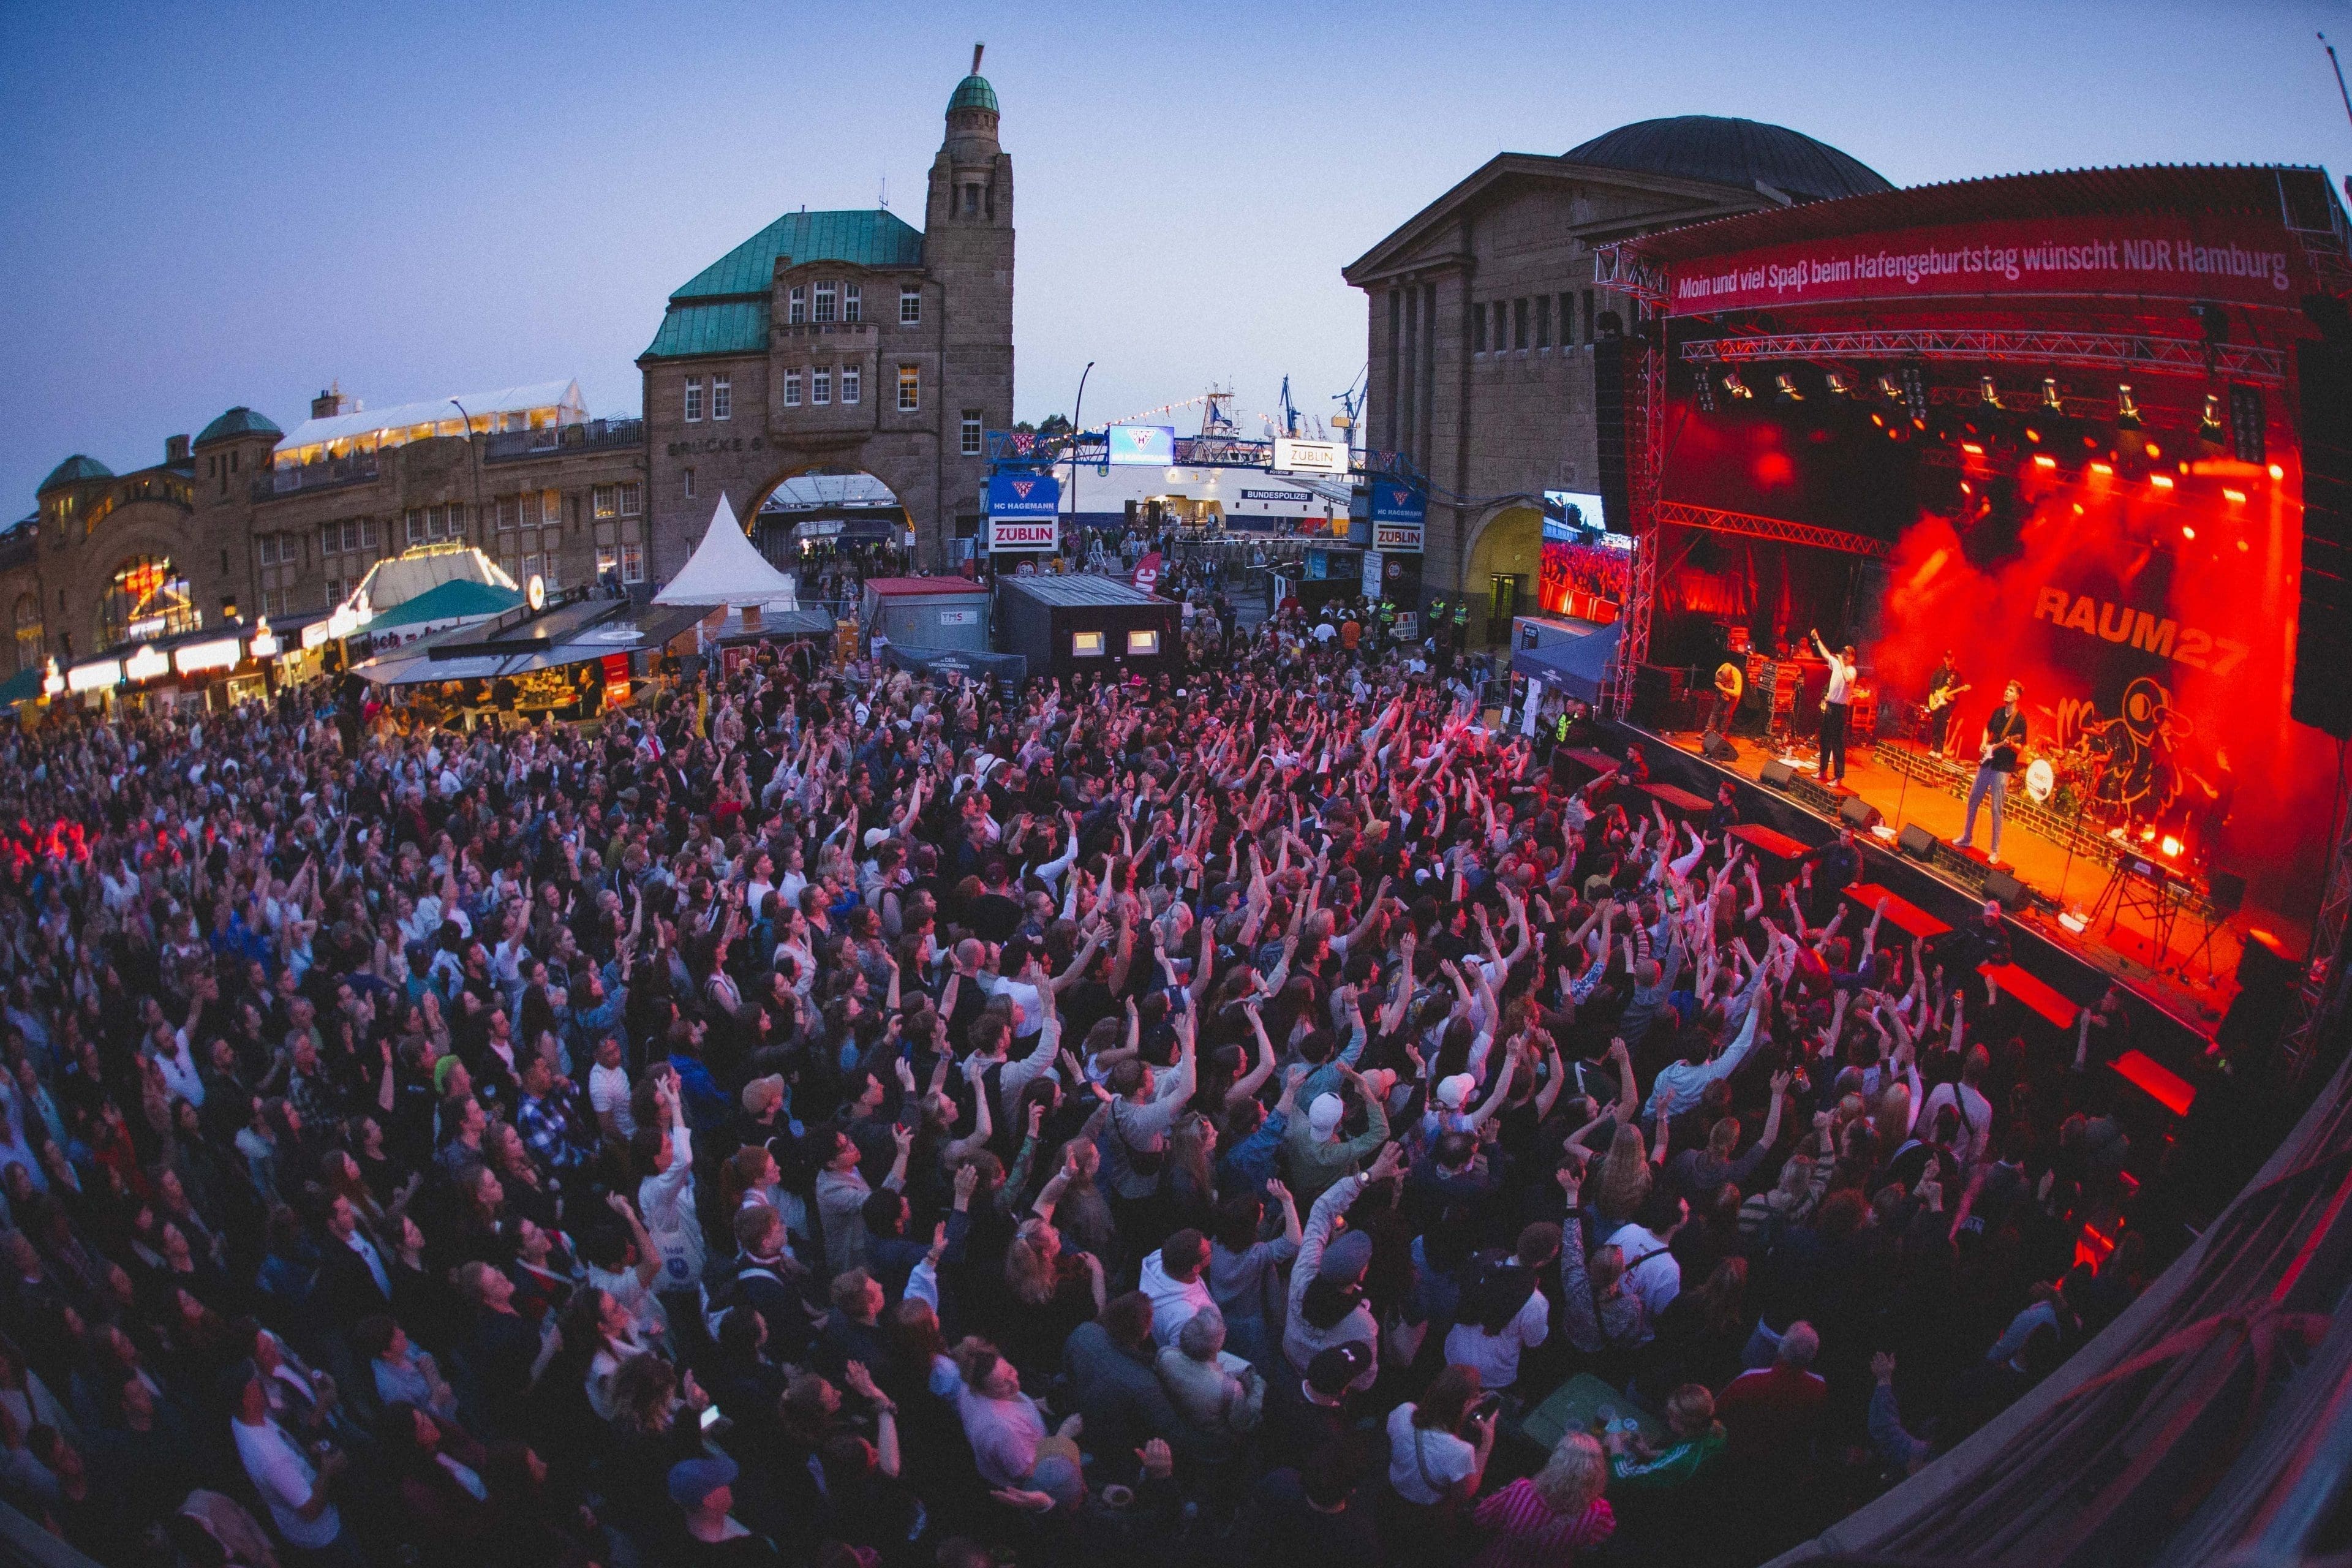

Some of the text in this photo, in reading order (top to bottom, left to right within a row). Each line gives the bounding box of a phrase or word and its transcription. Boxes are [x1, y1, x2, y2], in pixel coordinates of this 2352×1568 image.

[1678, 239, 2290, 299] Moin und viel Spaß beim Hafengeburtstag wünscht NDR Hamburg
[1248, 491, 1308, 500] BUNDESPOLIZEI
[995, 527, 1053, 540] ZÜBLIN
[1378, 531, 1420, 543] ZÜBLIN
[2034, 586, 2250, 677] RAUM27
